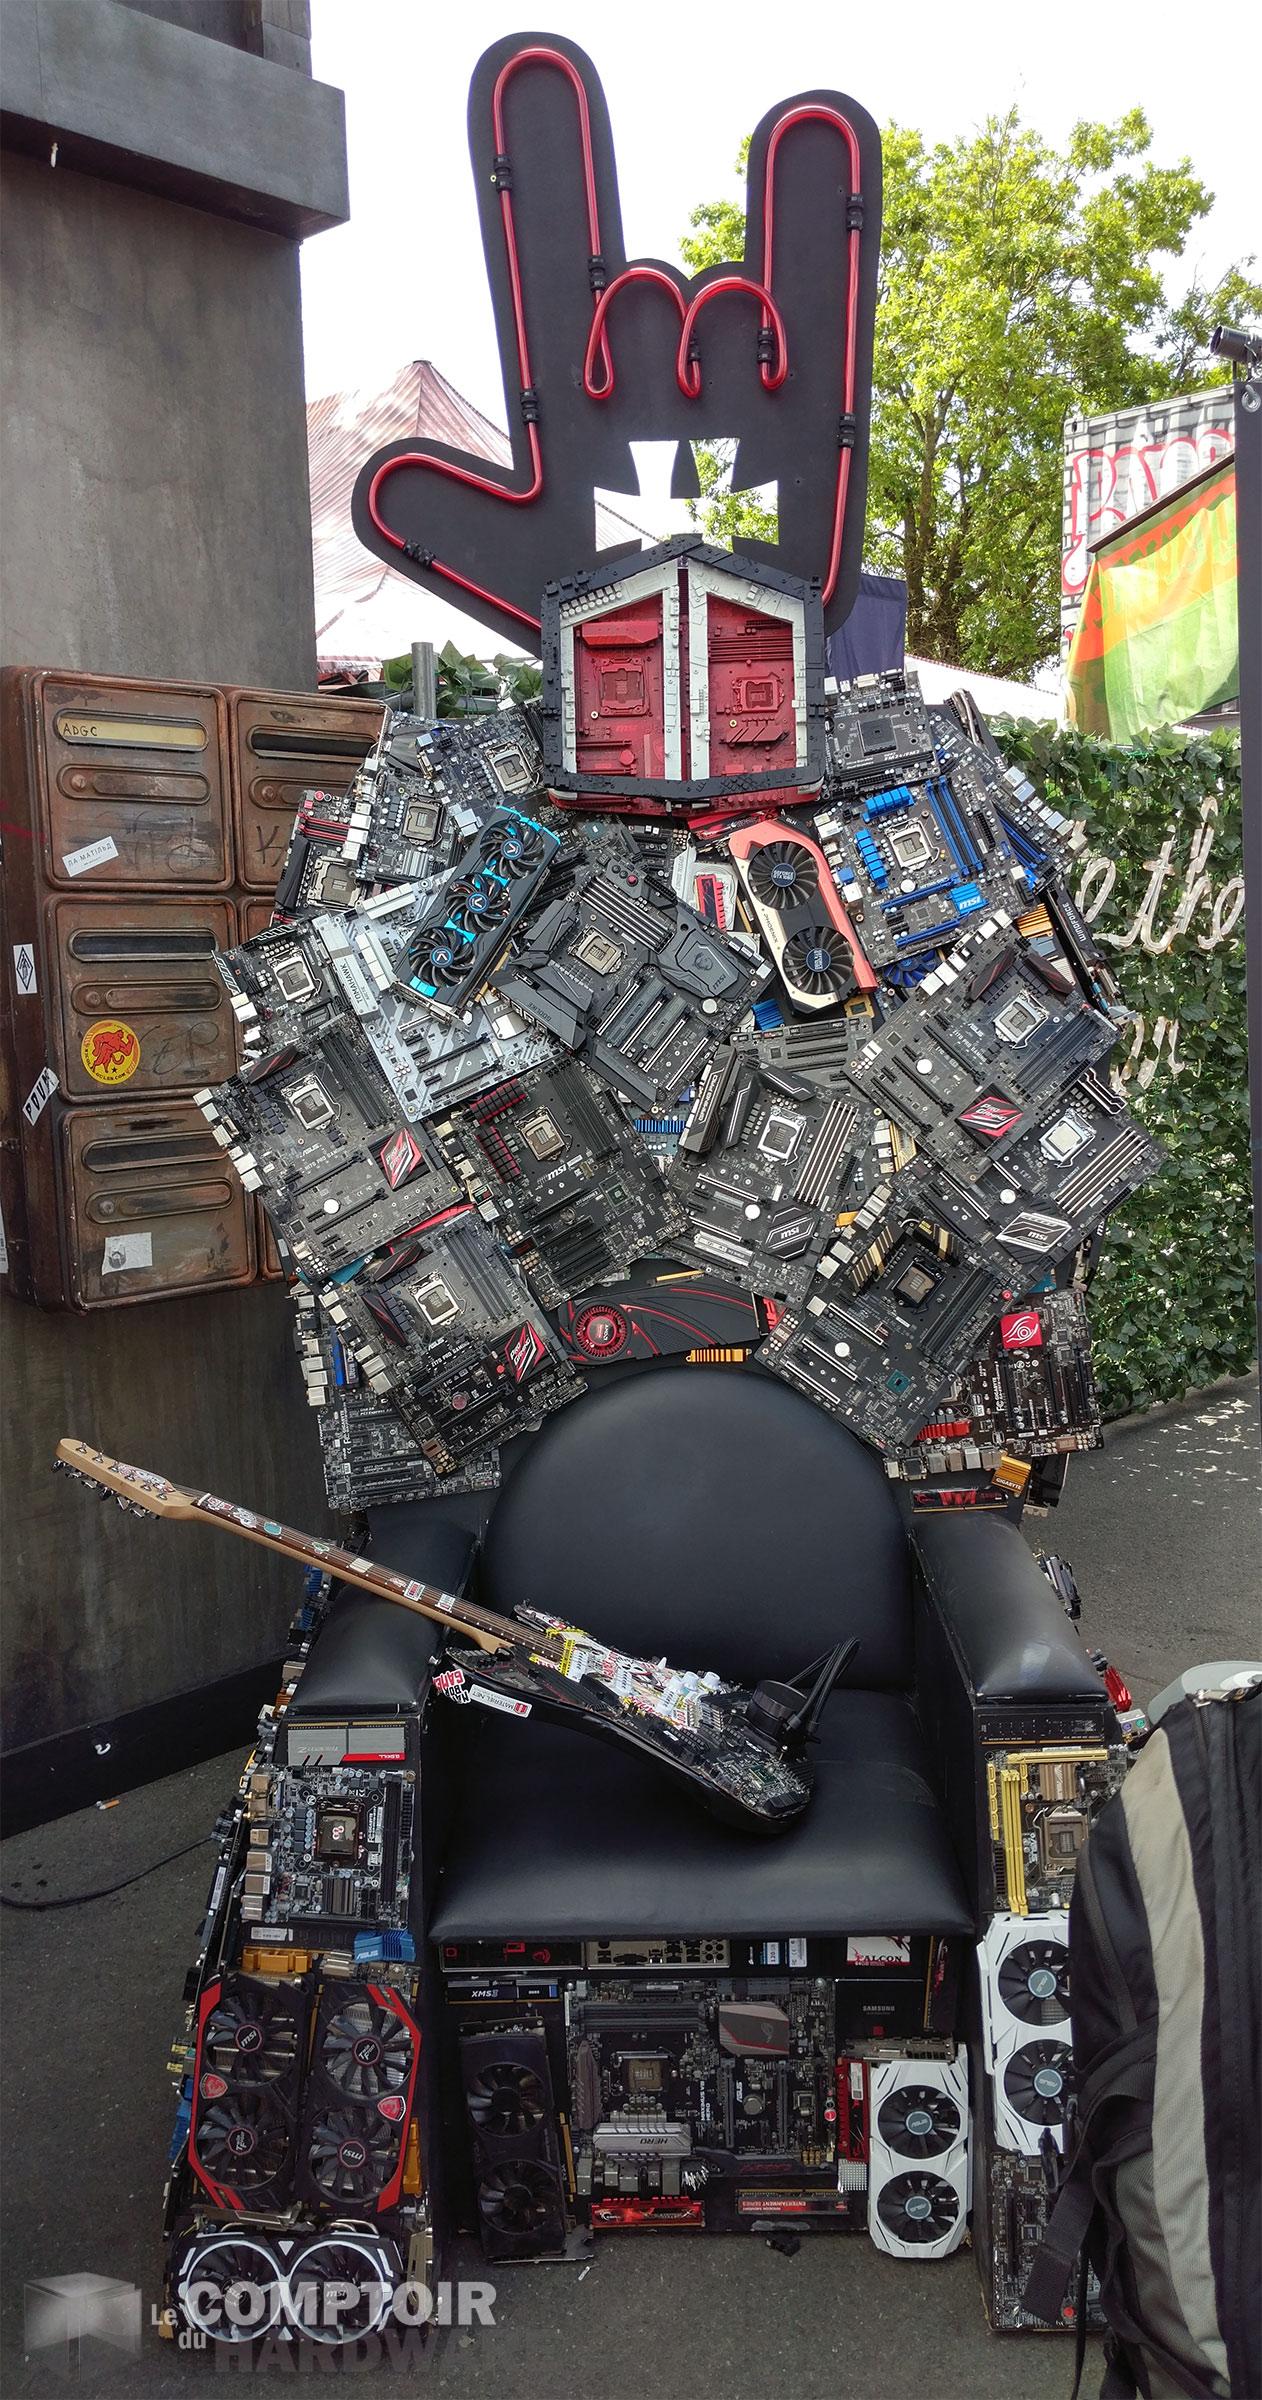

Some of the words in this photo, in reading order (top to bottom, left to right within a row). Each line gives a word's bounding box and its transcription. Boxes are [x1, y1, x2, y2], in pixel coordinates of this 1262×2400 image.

[63, 723, 98, 738] ADGC
[870, 899, 885, 908] msi
[958, 897, 982, 911] msi
[763, 913, 778, 943] PHOENIX
[1062, 901, 1087, 943] WINDFORCE
[340, 964, 362, 1005] TOMAHAWK
[713, 974, 727, 990] msi
[968, 1022, 985, 1038] ASUS
[962, 1038, 972, 1049] PRO
[971, 1046, 988, 1063] GAMING
[697, 1090, 713, 1122] GAMING
[706, 1073, 719, 1091] PRO
[975, 1108, 1008, 1122] GAMING
[980, 1103, 1001, 1113] PRO
[547, 1164, 568, 1181] msi
[780, 1226, 800, 1239] msi
[1027, 1231, 1049, 1241] msi
[428, 1337, 445, 1350] ASUS
[510, 1341, 521, 1360] PRO
[442, 1350, 452, 1361] PRO
[452, 1341, 471, 1355] GAMING
[513, 1336, 531, 1366] GAMING
[995, 1477, 1023, 1491] GIGABYTE
[356, 1949, 379, 1960] ASUS
[856, 1950, 903, 1963] FALCON
[862, 2004, 896, 2012] SAMSUNG
[240, 2030, 257, 2047] msi
[639, 2137, 668, 2145] HERO
[343, 2149, 364, 2160] msi
